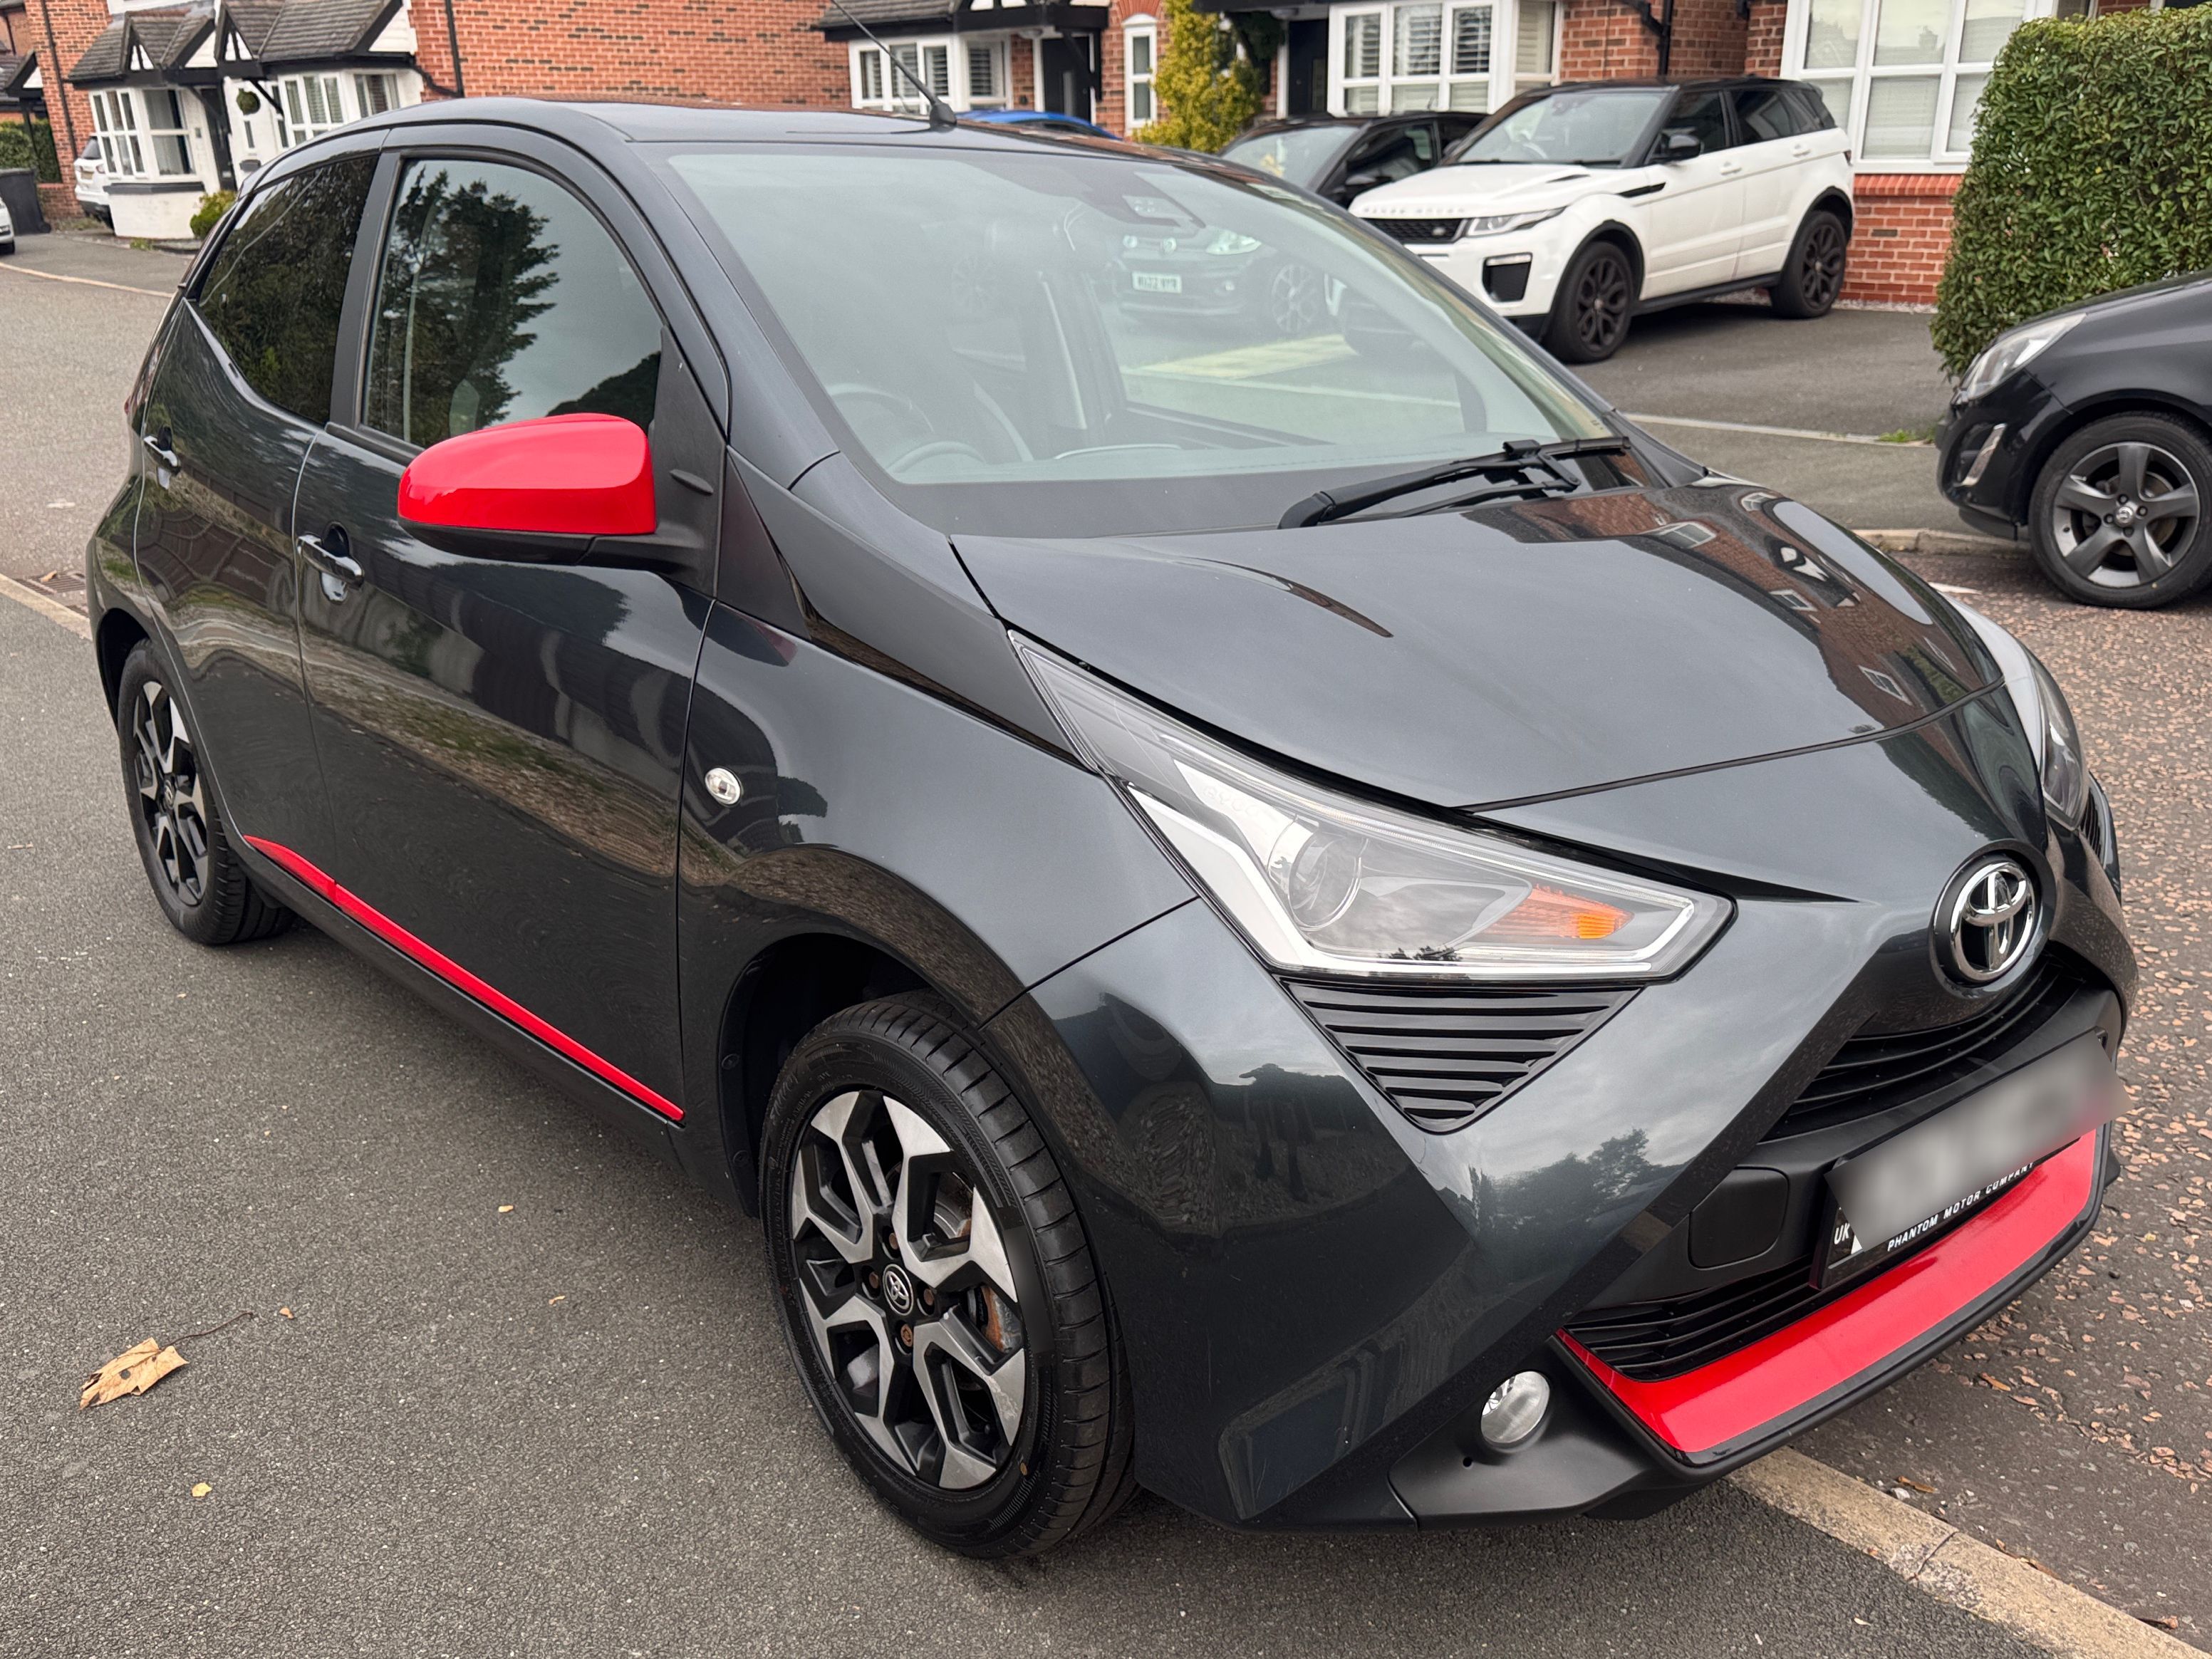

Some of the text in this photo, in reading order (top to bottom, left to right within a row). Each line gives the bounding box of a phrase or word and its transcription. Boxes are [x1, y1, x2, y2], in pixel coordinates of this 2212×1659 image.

[1834, 1222, 1851, 1245] UK
[1887, 1214, 1938, 1252] PHANTOM
[1943, 1190, 1981, 1219] MOTOR
